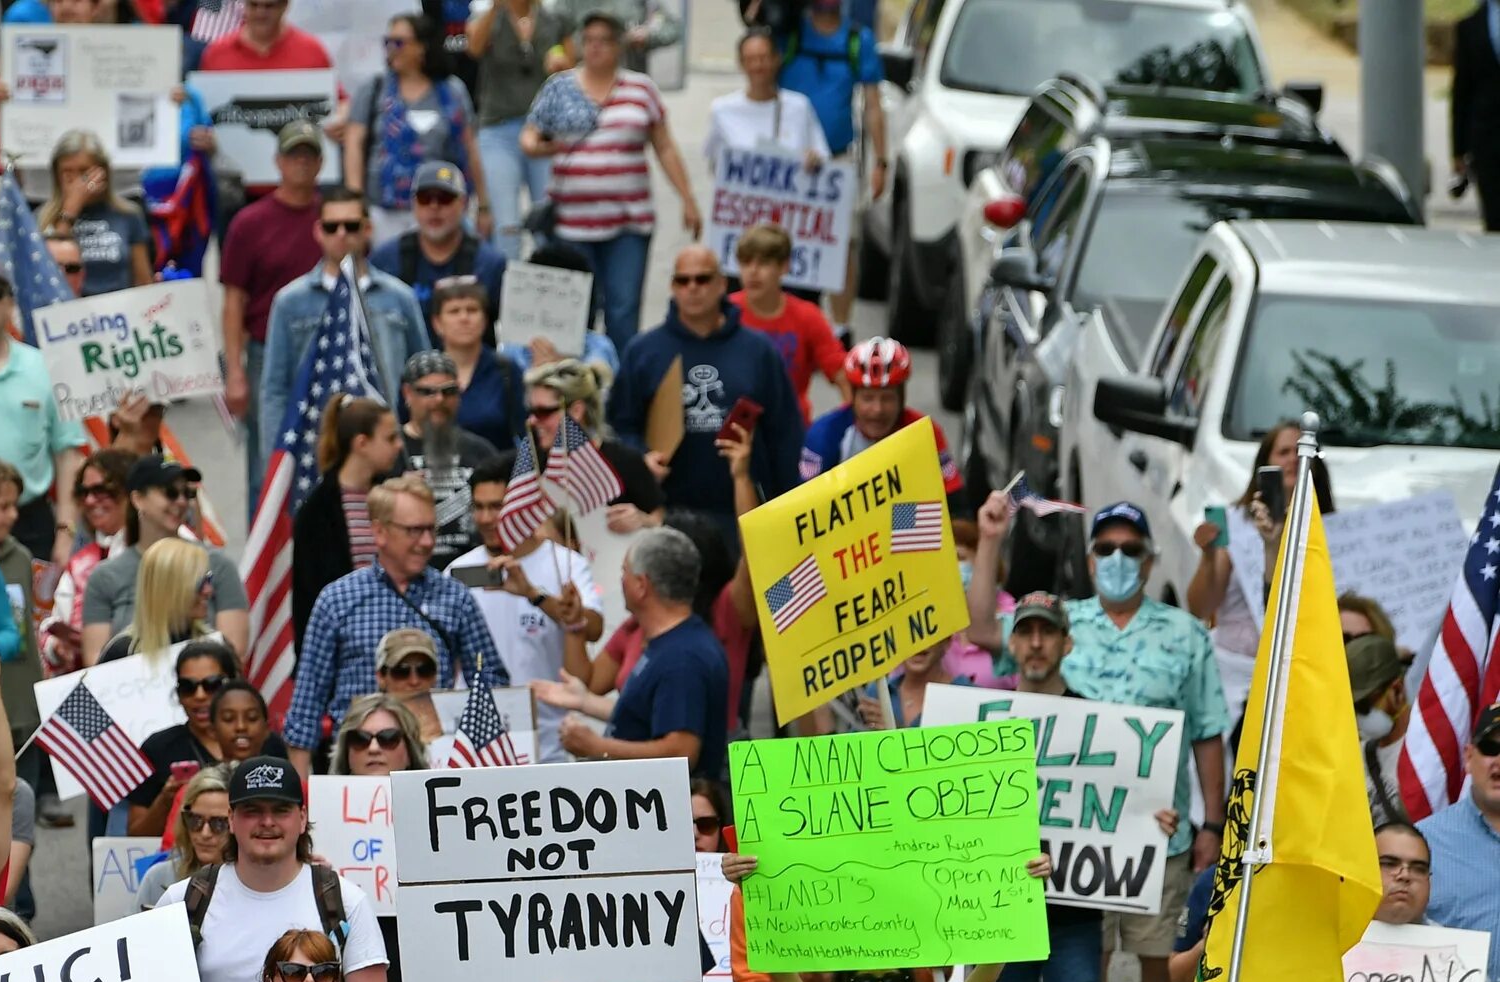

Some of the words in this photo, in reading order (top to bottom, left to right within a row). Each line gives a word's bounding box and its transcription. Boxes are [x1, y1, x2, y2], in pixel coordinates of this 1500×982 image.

[724, 149, 800, 192] WORK
[42, 307, 130, 343] Losing
[81, 321, 184, 378] Rights
[795, 465, 903, 544] FLATTEN
[833, 531, 883, 580] THE
[835, 571, 908, 633] FEAR!
[802, 628, 897, 698] REOPEN
[908, 604, 940, 639] NC
[791, 738, 863, 785] MAN
[425, 777, 668, 852] FREEDOM
[740, 798, 762, 842] A
[779, 785, 893, 837] SLAVE
[906, 769, 1030, 821] OBEYS
[353, 839, 383, 863] OF
[507, 840, 595, 872] NOT
[944, 836, 984, 862] Ryan
[935, 867, 992, 890] Open
[1000, 866, 1026, 884] NC
[436, 889, 685, 961] TYRANNY
[946, 891, 987, 920] May
